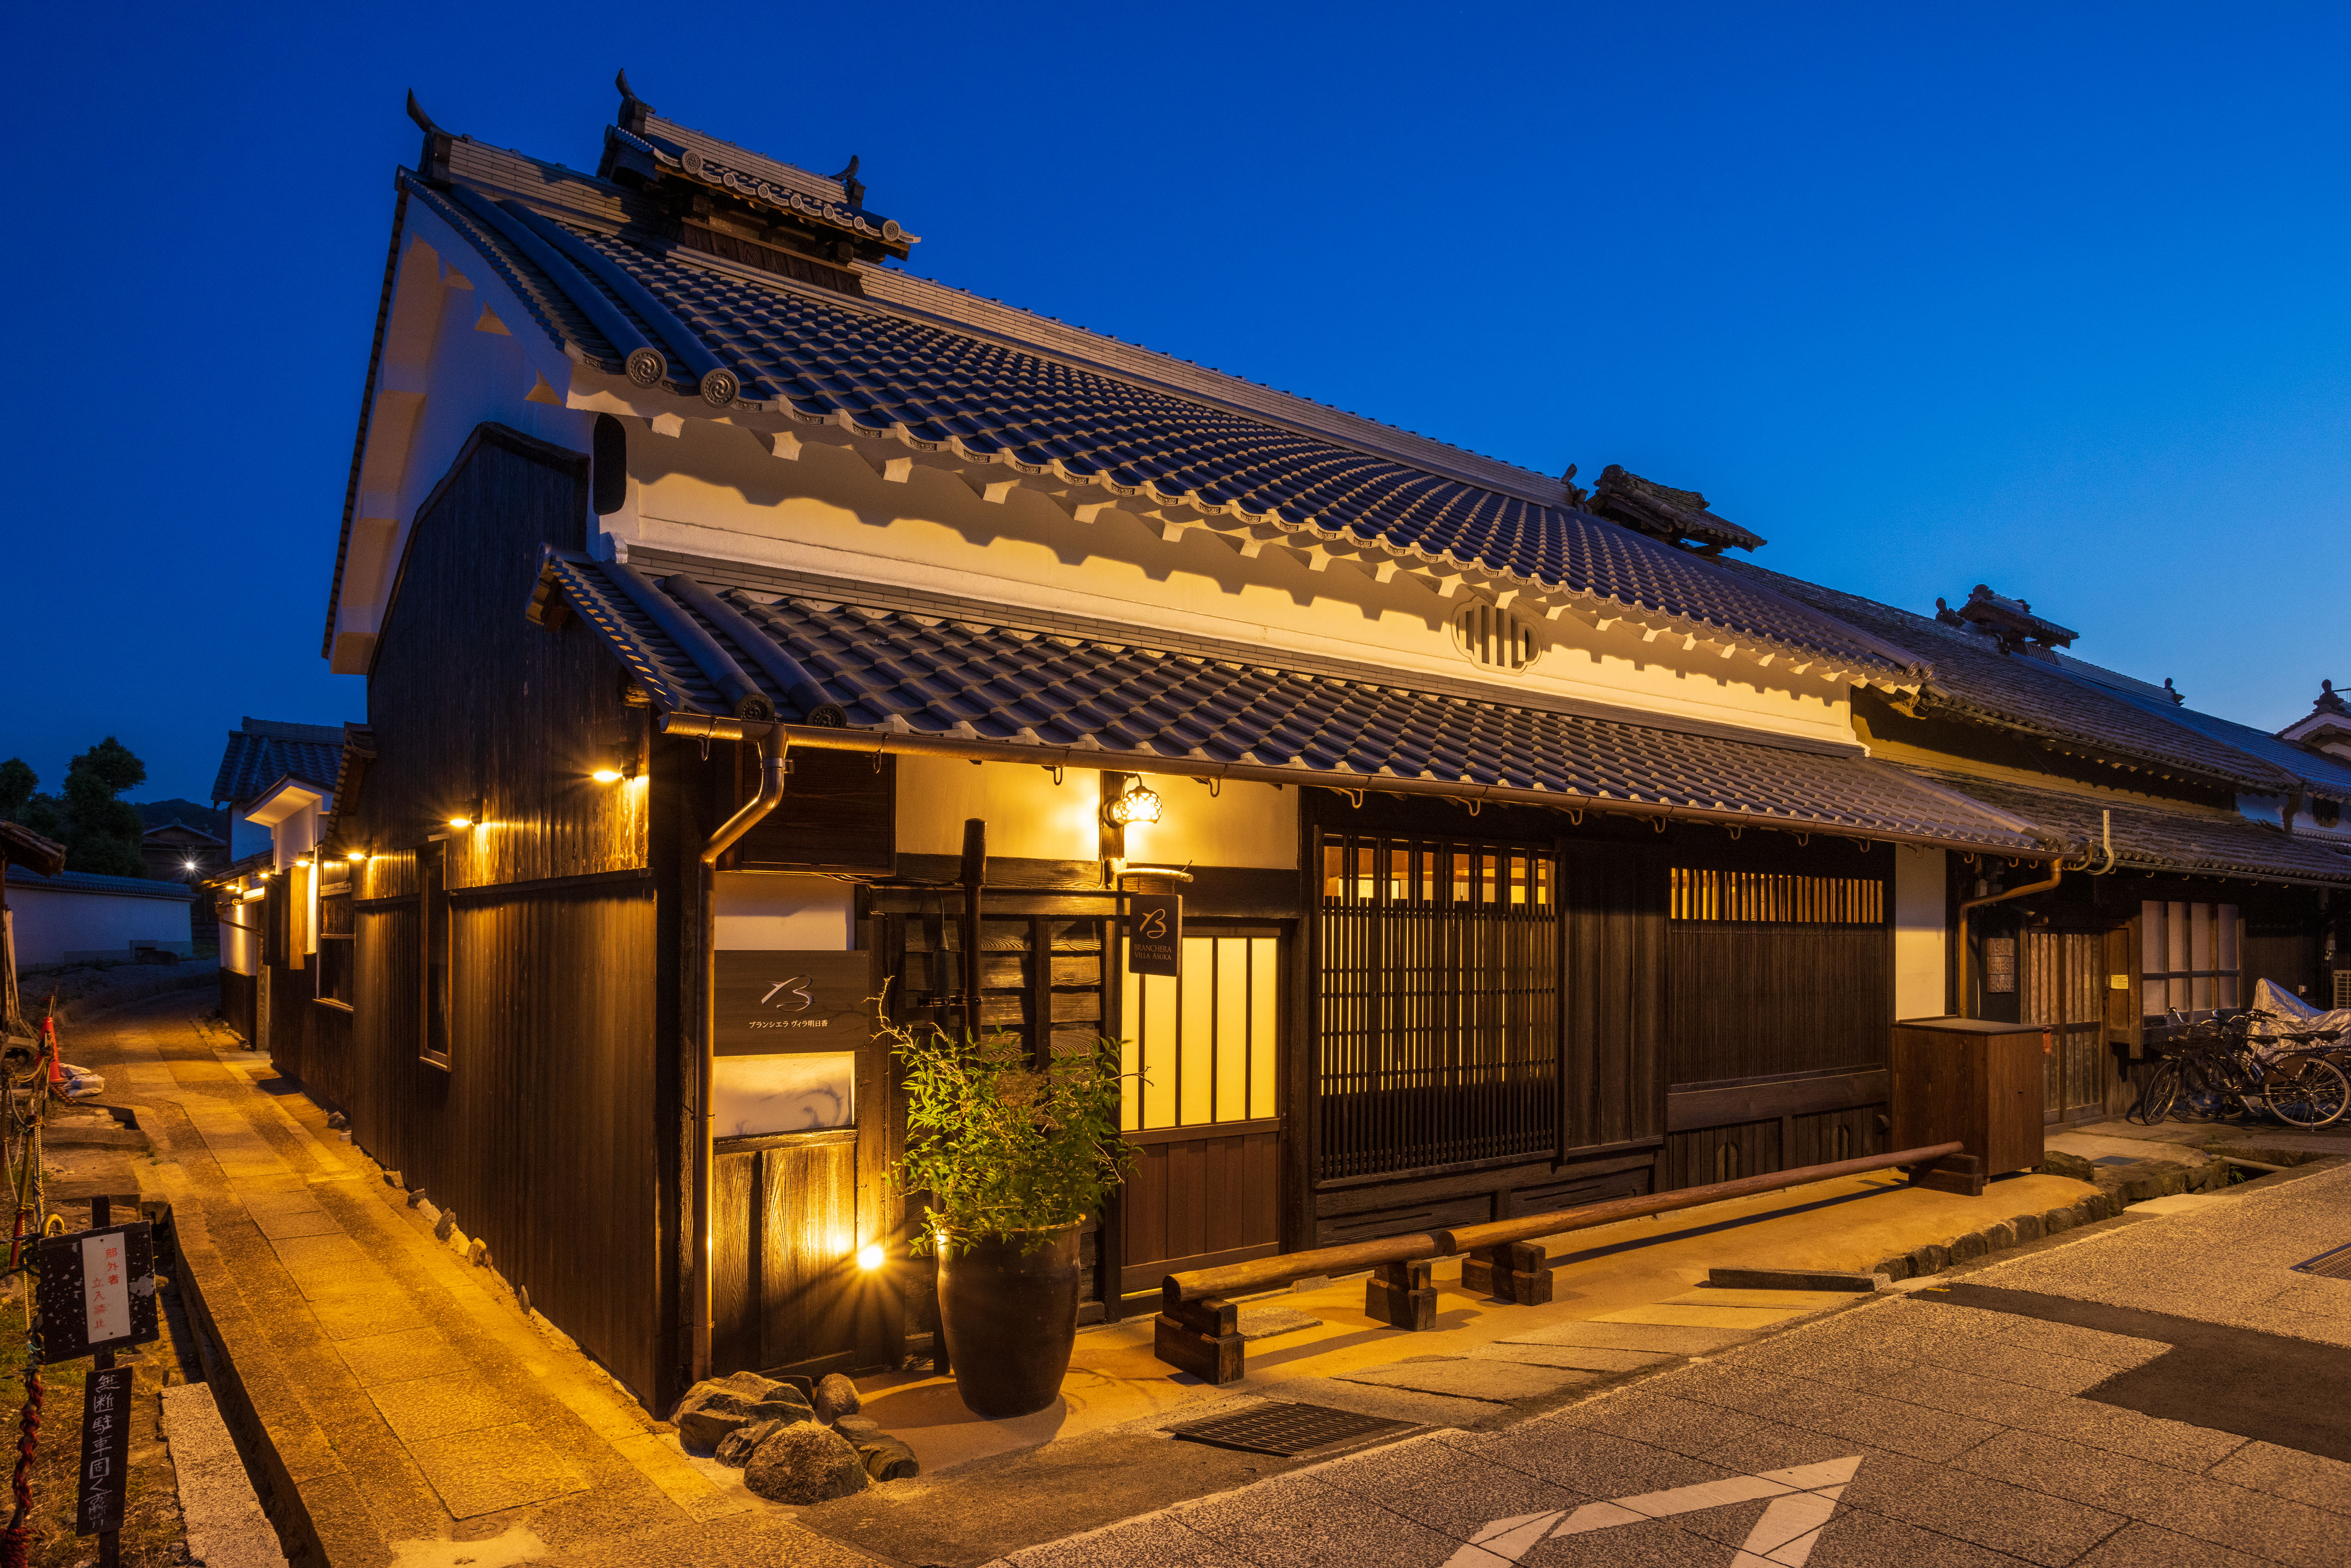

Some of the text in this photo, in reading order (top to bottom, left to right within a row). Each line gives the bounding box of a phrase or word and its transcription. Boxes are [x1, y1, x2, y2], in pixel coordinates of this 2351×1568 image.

[1134, 944, 1172, 953] BRANCHERA
[791, 1019, 828, 1027] ヴィラ明日香
[105, 1247, 119, 1285] 部外者
[92, 1277, 107, 1329] 立入禁止
